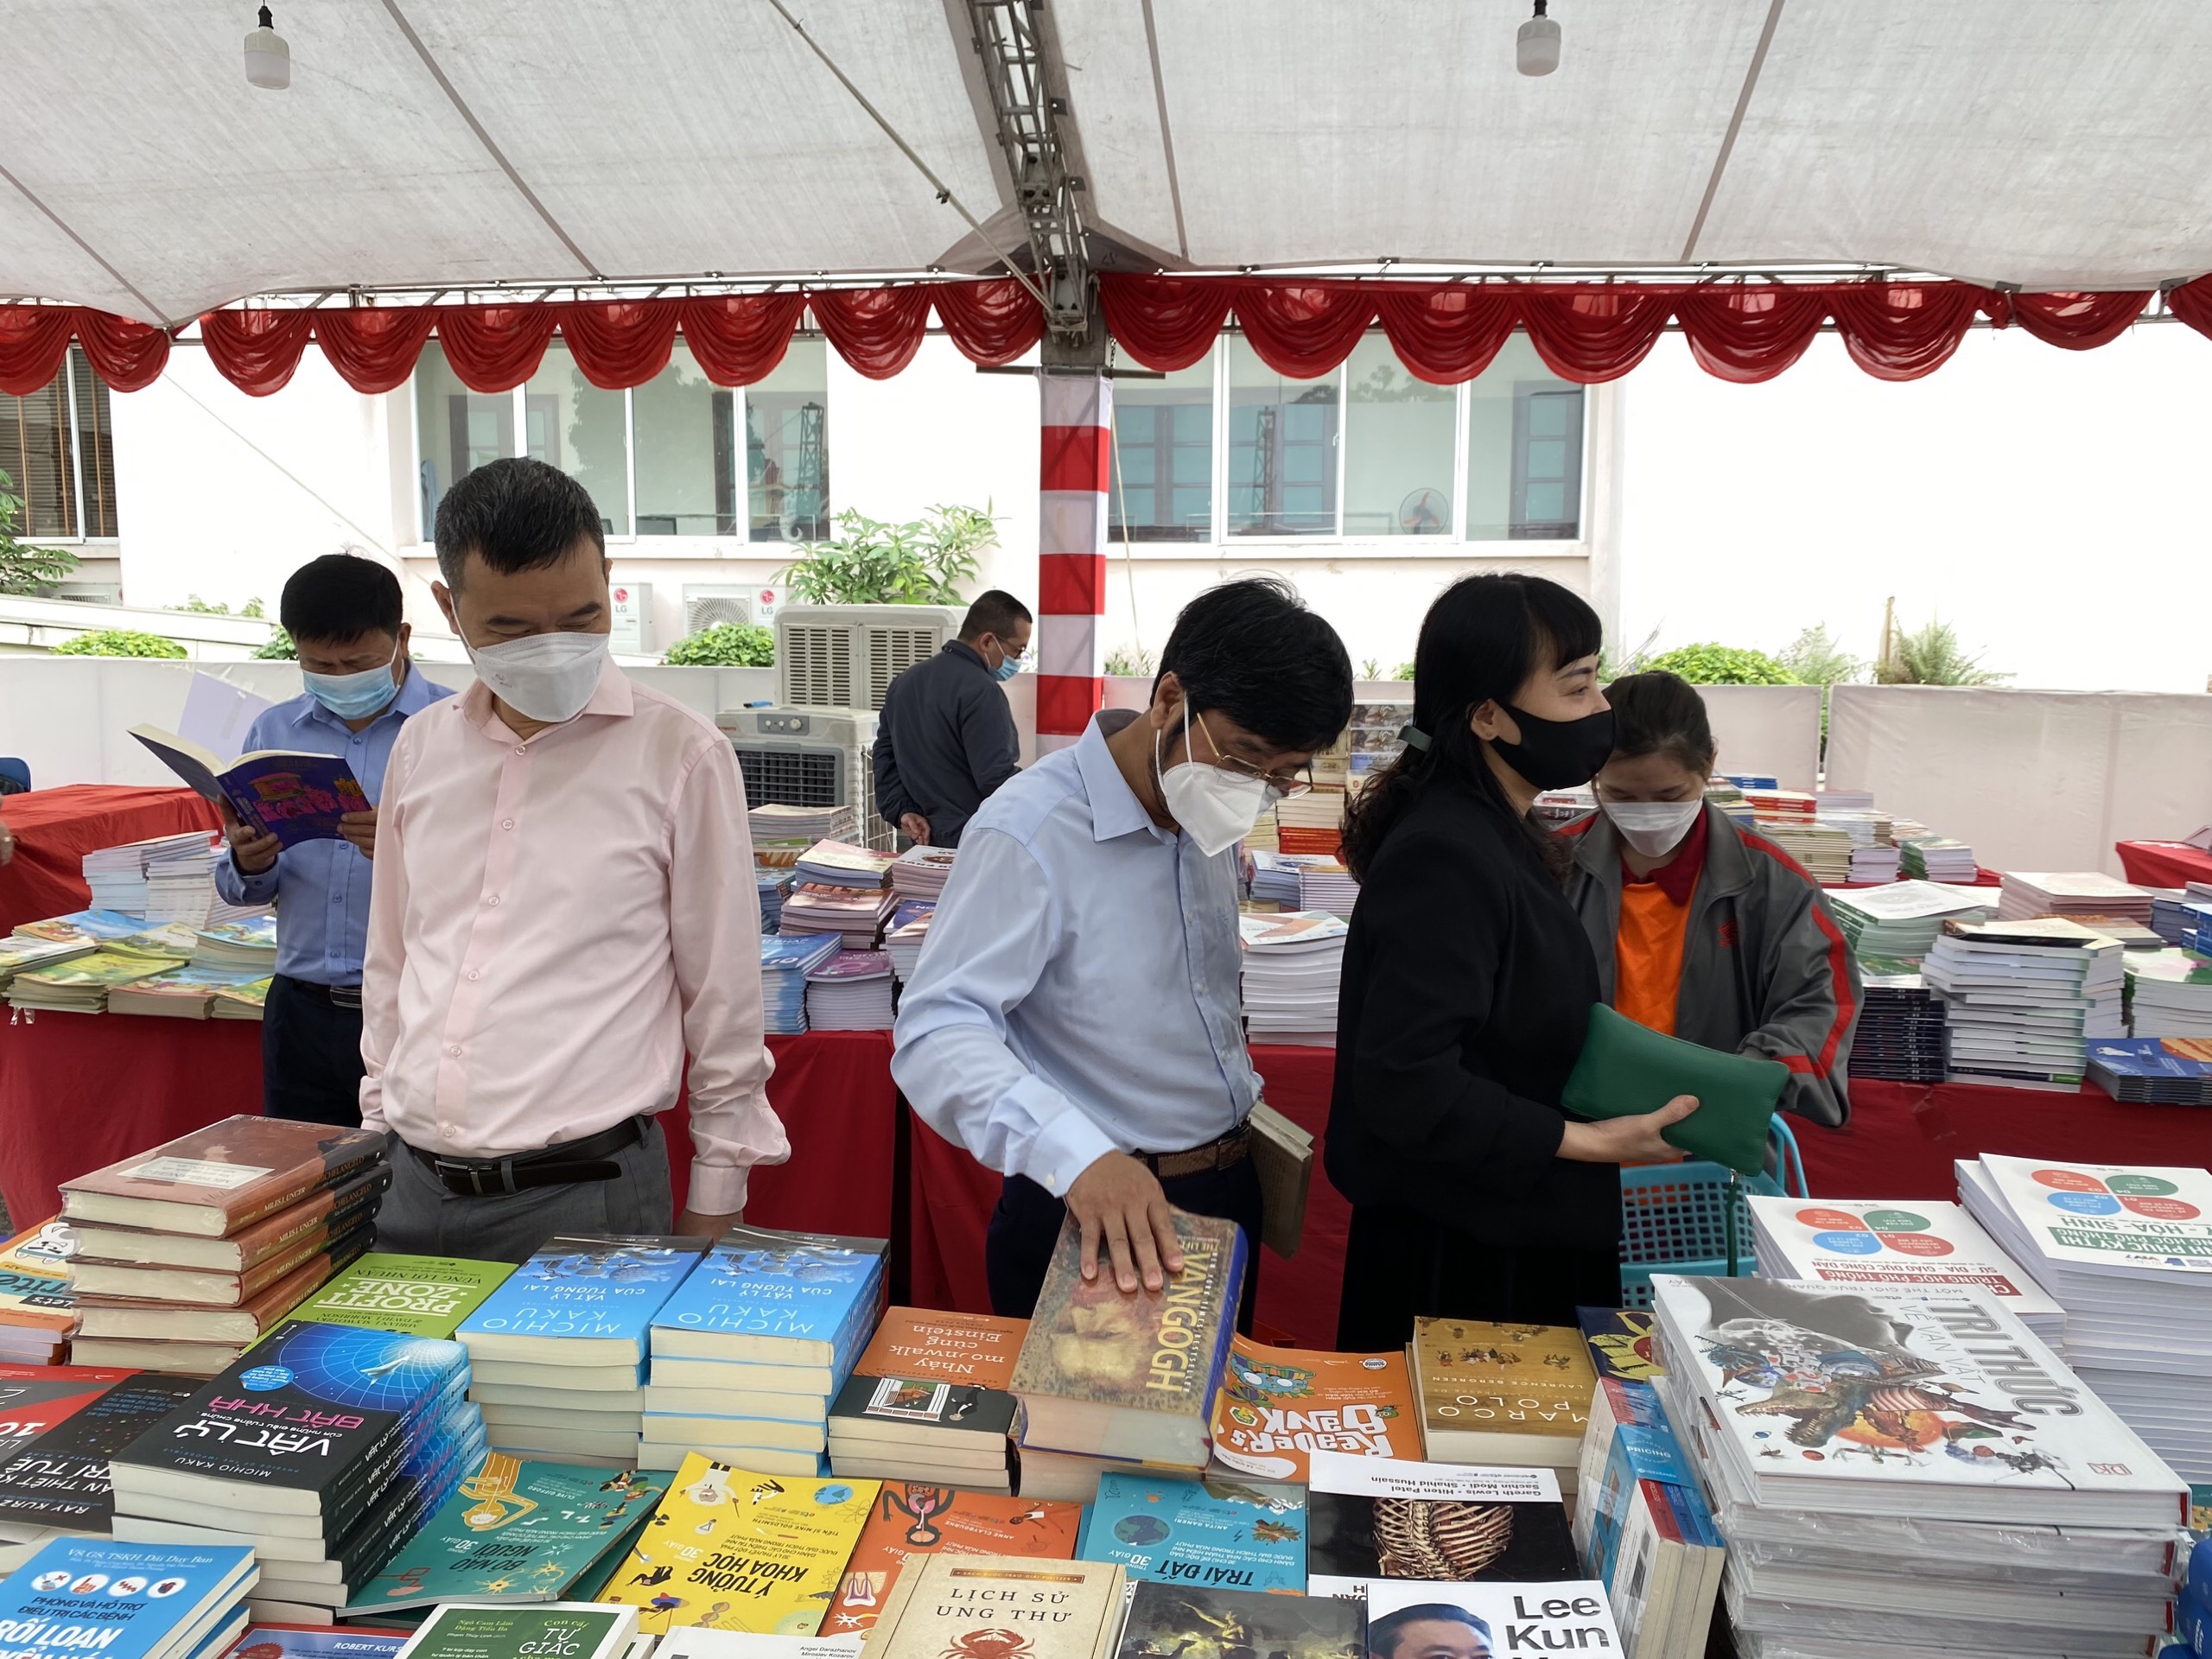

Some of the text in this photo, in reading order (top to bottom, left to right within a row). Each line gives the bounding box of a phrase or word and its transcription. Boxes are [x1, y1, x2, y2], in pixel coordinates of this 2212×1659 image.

[615, 605, 627, 613] LG
[761, 607, 773, 615] LG
[2060, 1217, 2184, 1236] HÓA SINH
[2056, 1228, 2212, 1246] NG HỌC PHỔ THÔNG
[2060, 1236, 2212, 1255] NH PHỤC KỲ THI
[1811, 1261, 1998, 1274] SỬ ĐỊA GIÁO DỤC CÔNG DÂN
[710, 1279, 737, 1287] LAI
[1825, 1270, 2004, 1285] TRUNG HỌC PHỔ THÔNG
[349, 1280, 460, 1299] ZONE
[553, 1286, 607, 1295] TƯƠNG
[613, 1287, 645, 1296] CỦA
[738, 1289, 793, 1300] VẬT LÝ
[740, 1282, 794, 1293] TƯƠNG
[31, 1296, 74, 1307] Let's
[312, 1292, 461, 1313] PROFIT
[575, 1293, 605, 1301] VẬT
[515, 1307, 607, 1321] KAKU
[709, 1303, 798, 1319] KAKU
[1899, 1305, 1934, 1321] VỀ
[482, 1319, 621, 1334] MICHIO
[677, 1312, 814, 1334] MICHIO
[1146, 1251, 1211, 1393] VAN GOGH
[1182, 1252, 1219, 1393] NEW YORK TIMES BESTSELLER
[1927, 1305, 2013, 1340] TRI
[912, 1325, 1002, 1343] Einstein
[1916, 1325, 1957, 1351] VẠN
[925, 1336, 978, 1350] cùng
[914, 1358, 976, 1375] Nhảy
[1433, 1376, 1584, 1389] LAURENCE BERGREEN
[1456, 1395, 1571, 1411] POLO
[207, 1395, 365, 1430] BẤT KHẢ
[1438, 1405, 1590, 1423] MARCO
[173, 1419, 330, 1457] VẬT LÝ
[1626, 1445, 1672, 1459] PRICING
[4, 1457, 111, 1480] TRÍ TUỆ
[174, 1457, 272, 1478] MICHIO KAKU
[2088, 1462, 2132, 1478] DK
[1370, 1476, 1416, 1486] Hussain
[1419, 1480, 1459, 1489] Shahid
[527, 1486, 576, 1500] CLIVE GIFFORD
[1391, 1486, 1421, 1495] Patel
[50, 1503, 90, 1514] RAY
[945, 1521, 1015, 1541] ANNE CLAYBOURNE
[1173, 1517, 1229, 1531] ANITA GANERI
[471, 1543, 540, 1560] NGƯỜI
[1175, 1540, 1196, 1548] PHÚT
[681, 1547, 704, 1559] 30
[1130, 1554, 1153, 1566] 30
[448, 1557, 528, 1573] BỘ NÃO
[702, 1552, 810, 1583] KHOA HỌC
[1154, 1559, 1255, 1586] TRÁI ĐẤT
[686, 1567, 775, 1599] Ý TƯỞNG
[31, 1597, 149, 1612] PHÒNG VÀ HỖ TRỢ
[950, 1588, 1070, 1605] LỊCH SỬ
[17, 1605, 137, 1622] ĐIỀU TRỊ CÁC BỆNH
[937, 1605, 1072, 1623] UNG THƯ
[1513, 1595, 1602, 1620] Lee
[0, 1618, 125, 1651] RỐI LOẠN
[543, 1627, 582, 1643] TỰ
[1505, 1624, 1611, 1651] Kun
[334, 1642, 404, 1653] ROBERT KURS
[518, 1640, 581, 1656] GIÁC
